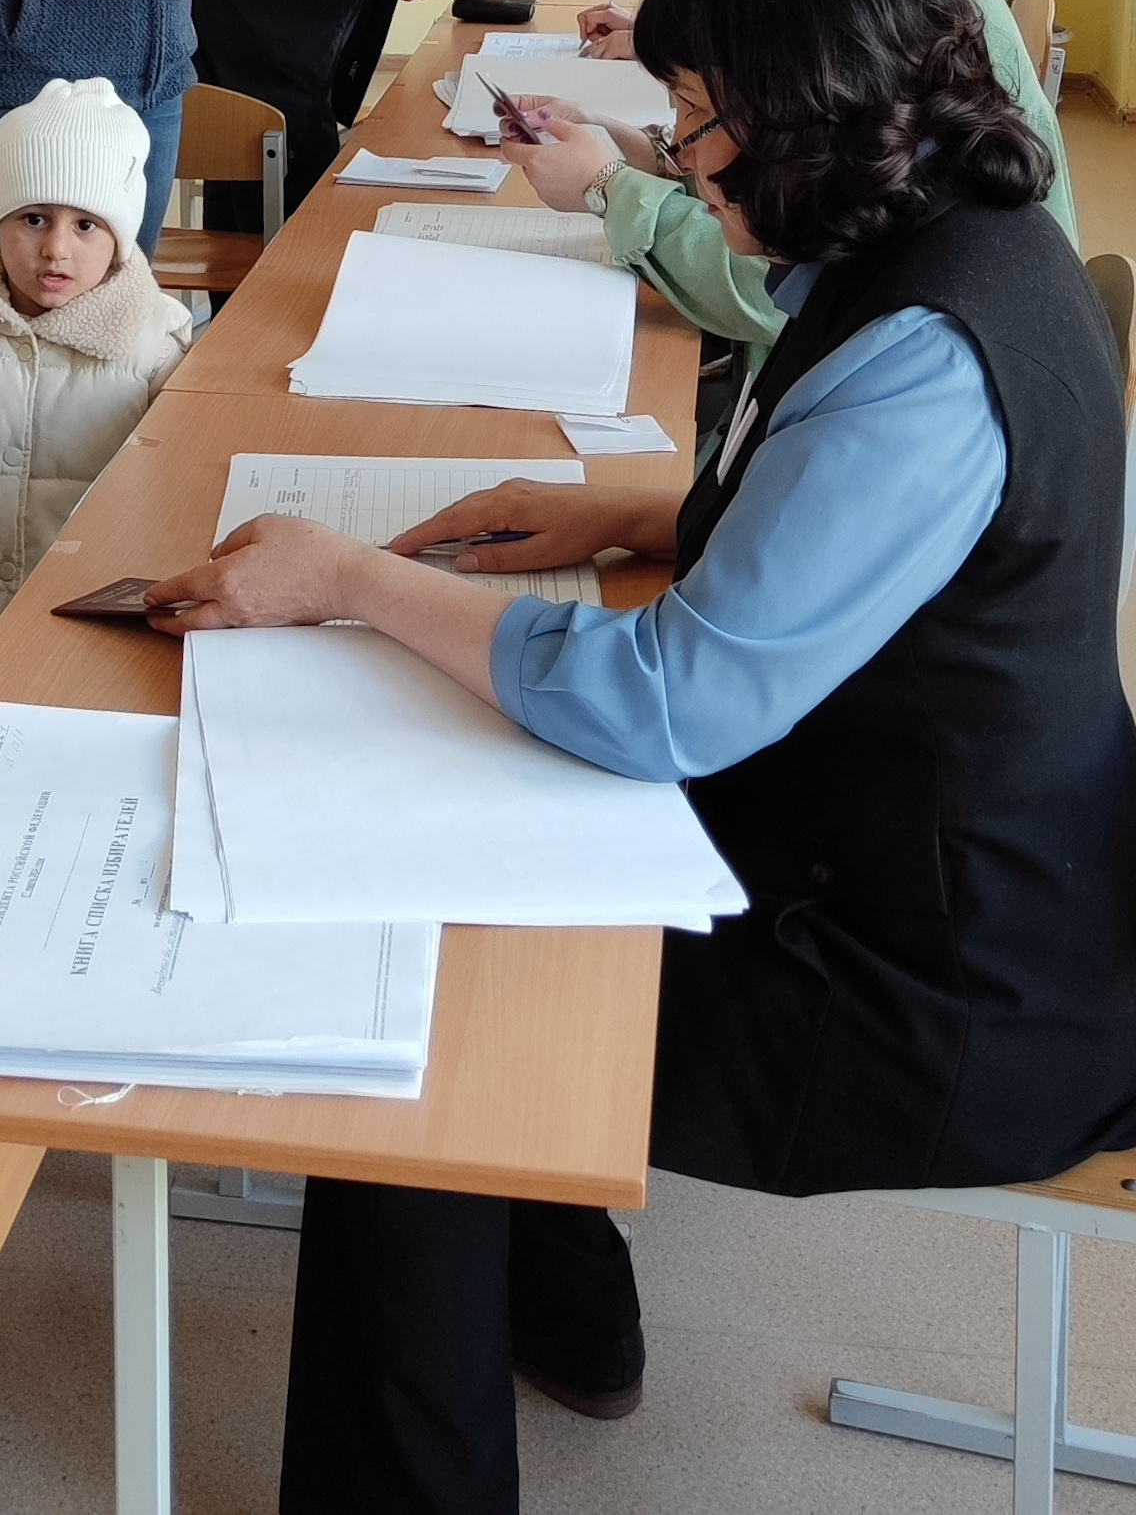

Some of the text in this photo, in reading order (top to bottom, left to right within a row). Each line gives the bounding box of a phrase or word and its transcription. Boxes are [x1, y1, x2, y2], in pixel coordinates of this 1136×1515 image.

[8, 834, 35, 884] РОССИЙСКОЙ
[69, 797, 139, 976] КНИГА СПИСКА ИЗБИРАТЕЛЕЙ
